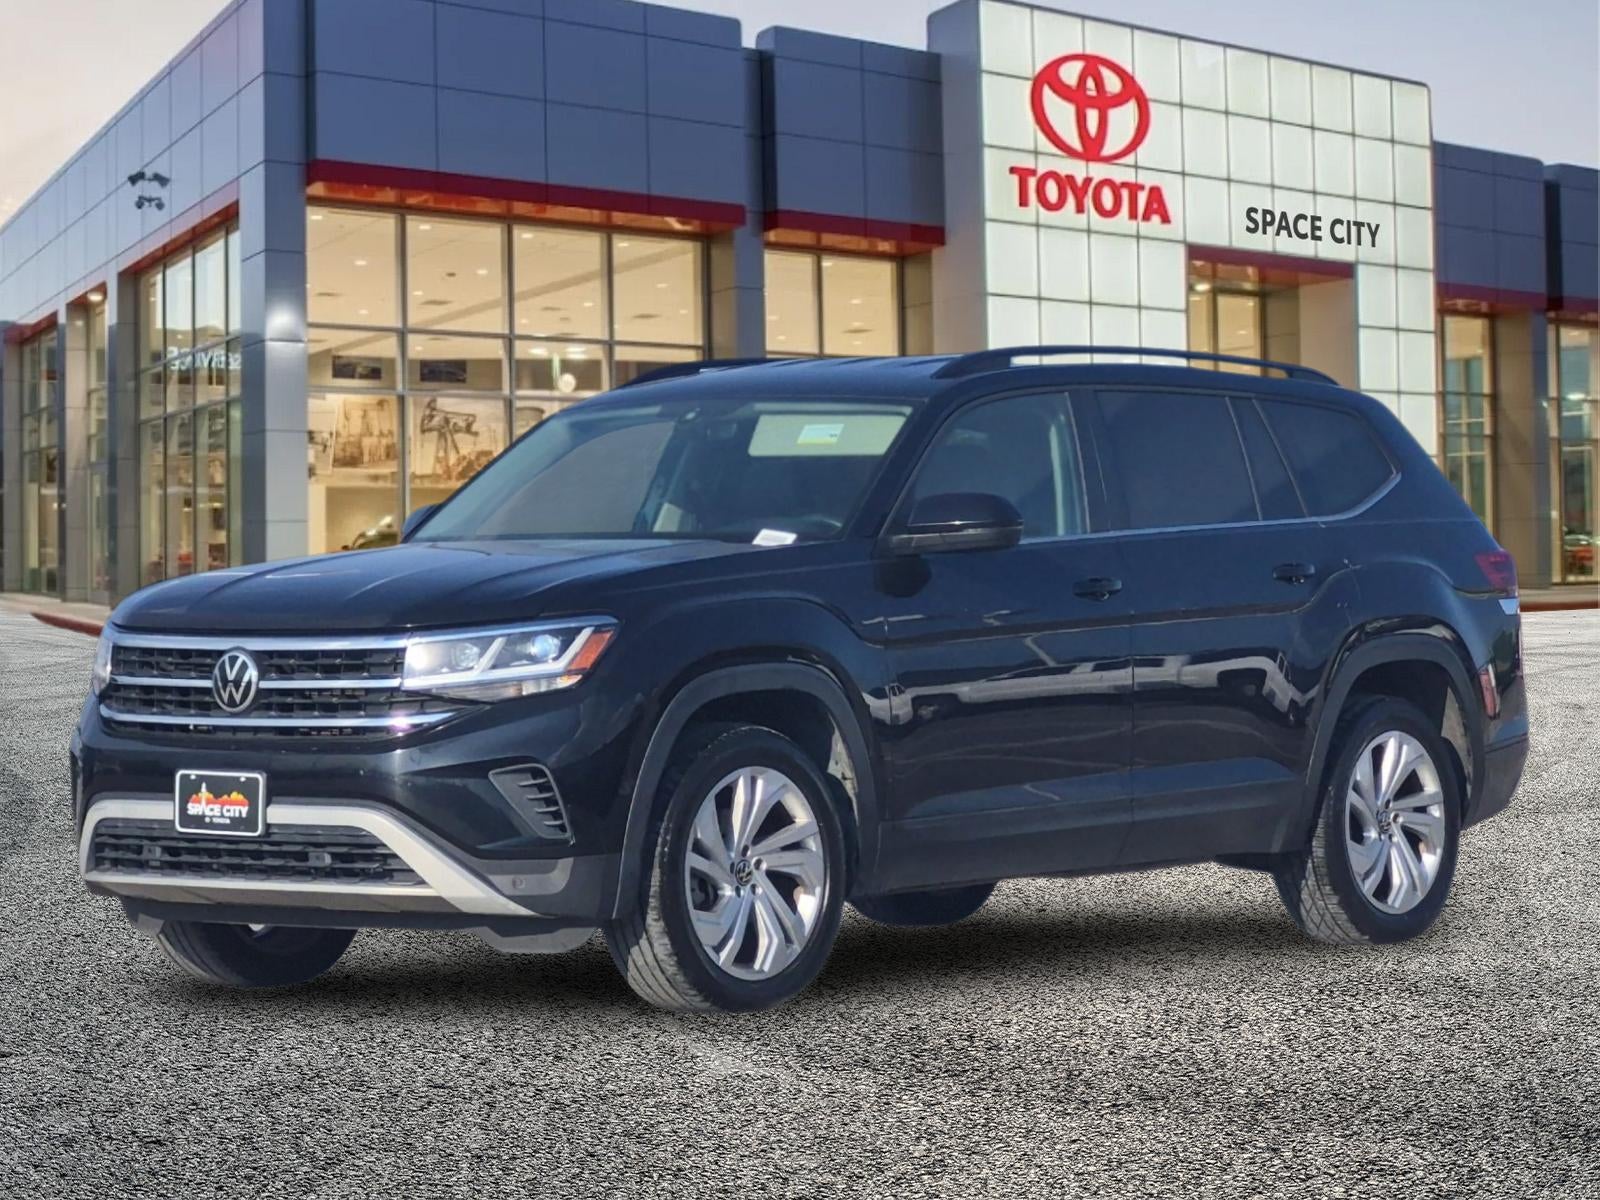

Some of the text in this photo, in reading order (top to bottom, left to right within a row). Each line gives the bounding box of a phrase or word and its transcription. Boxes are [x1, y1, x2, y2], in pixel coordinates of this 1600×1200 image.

[1009, 166, 1171, 224] TOYOTA
[1245, 206, 1381, 248] SPACE CITY
[214, 651, 256, 709] VW
[187, 802, 249, 818] SPACE CITY
